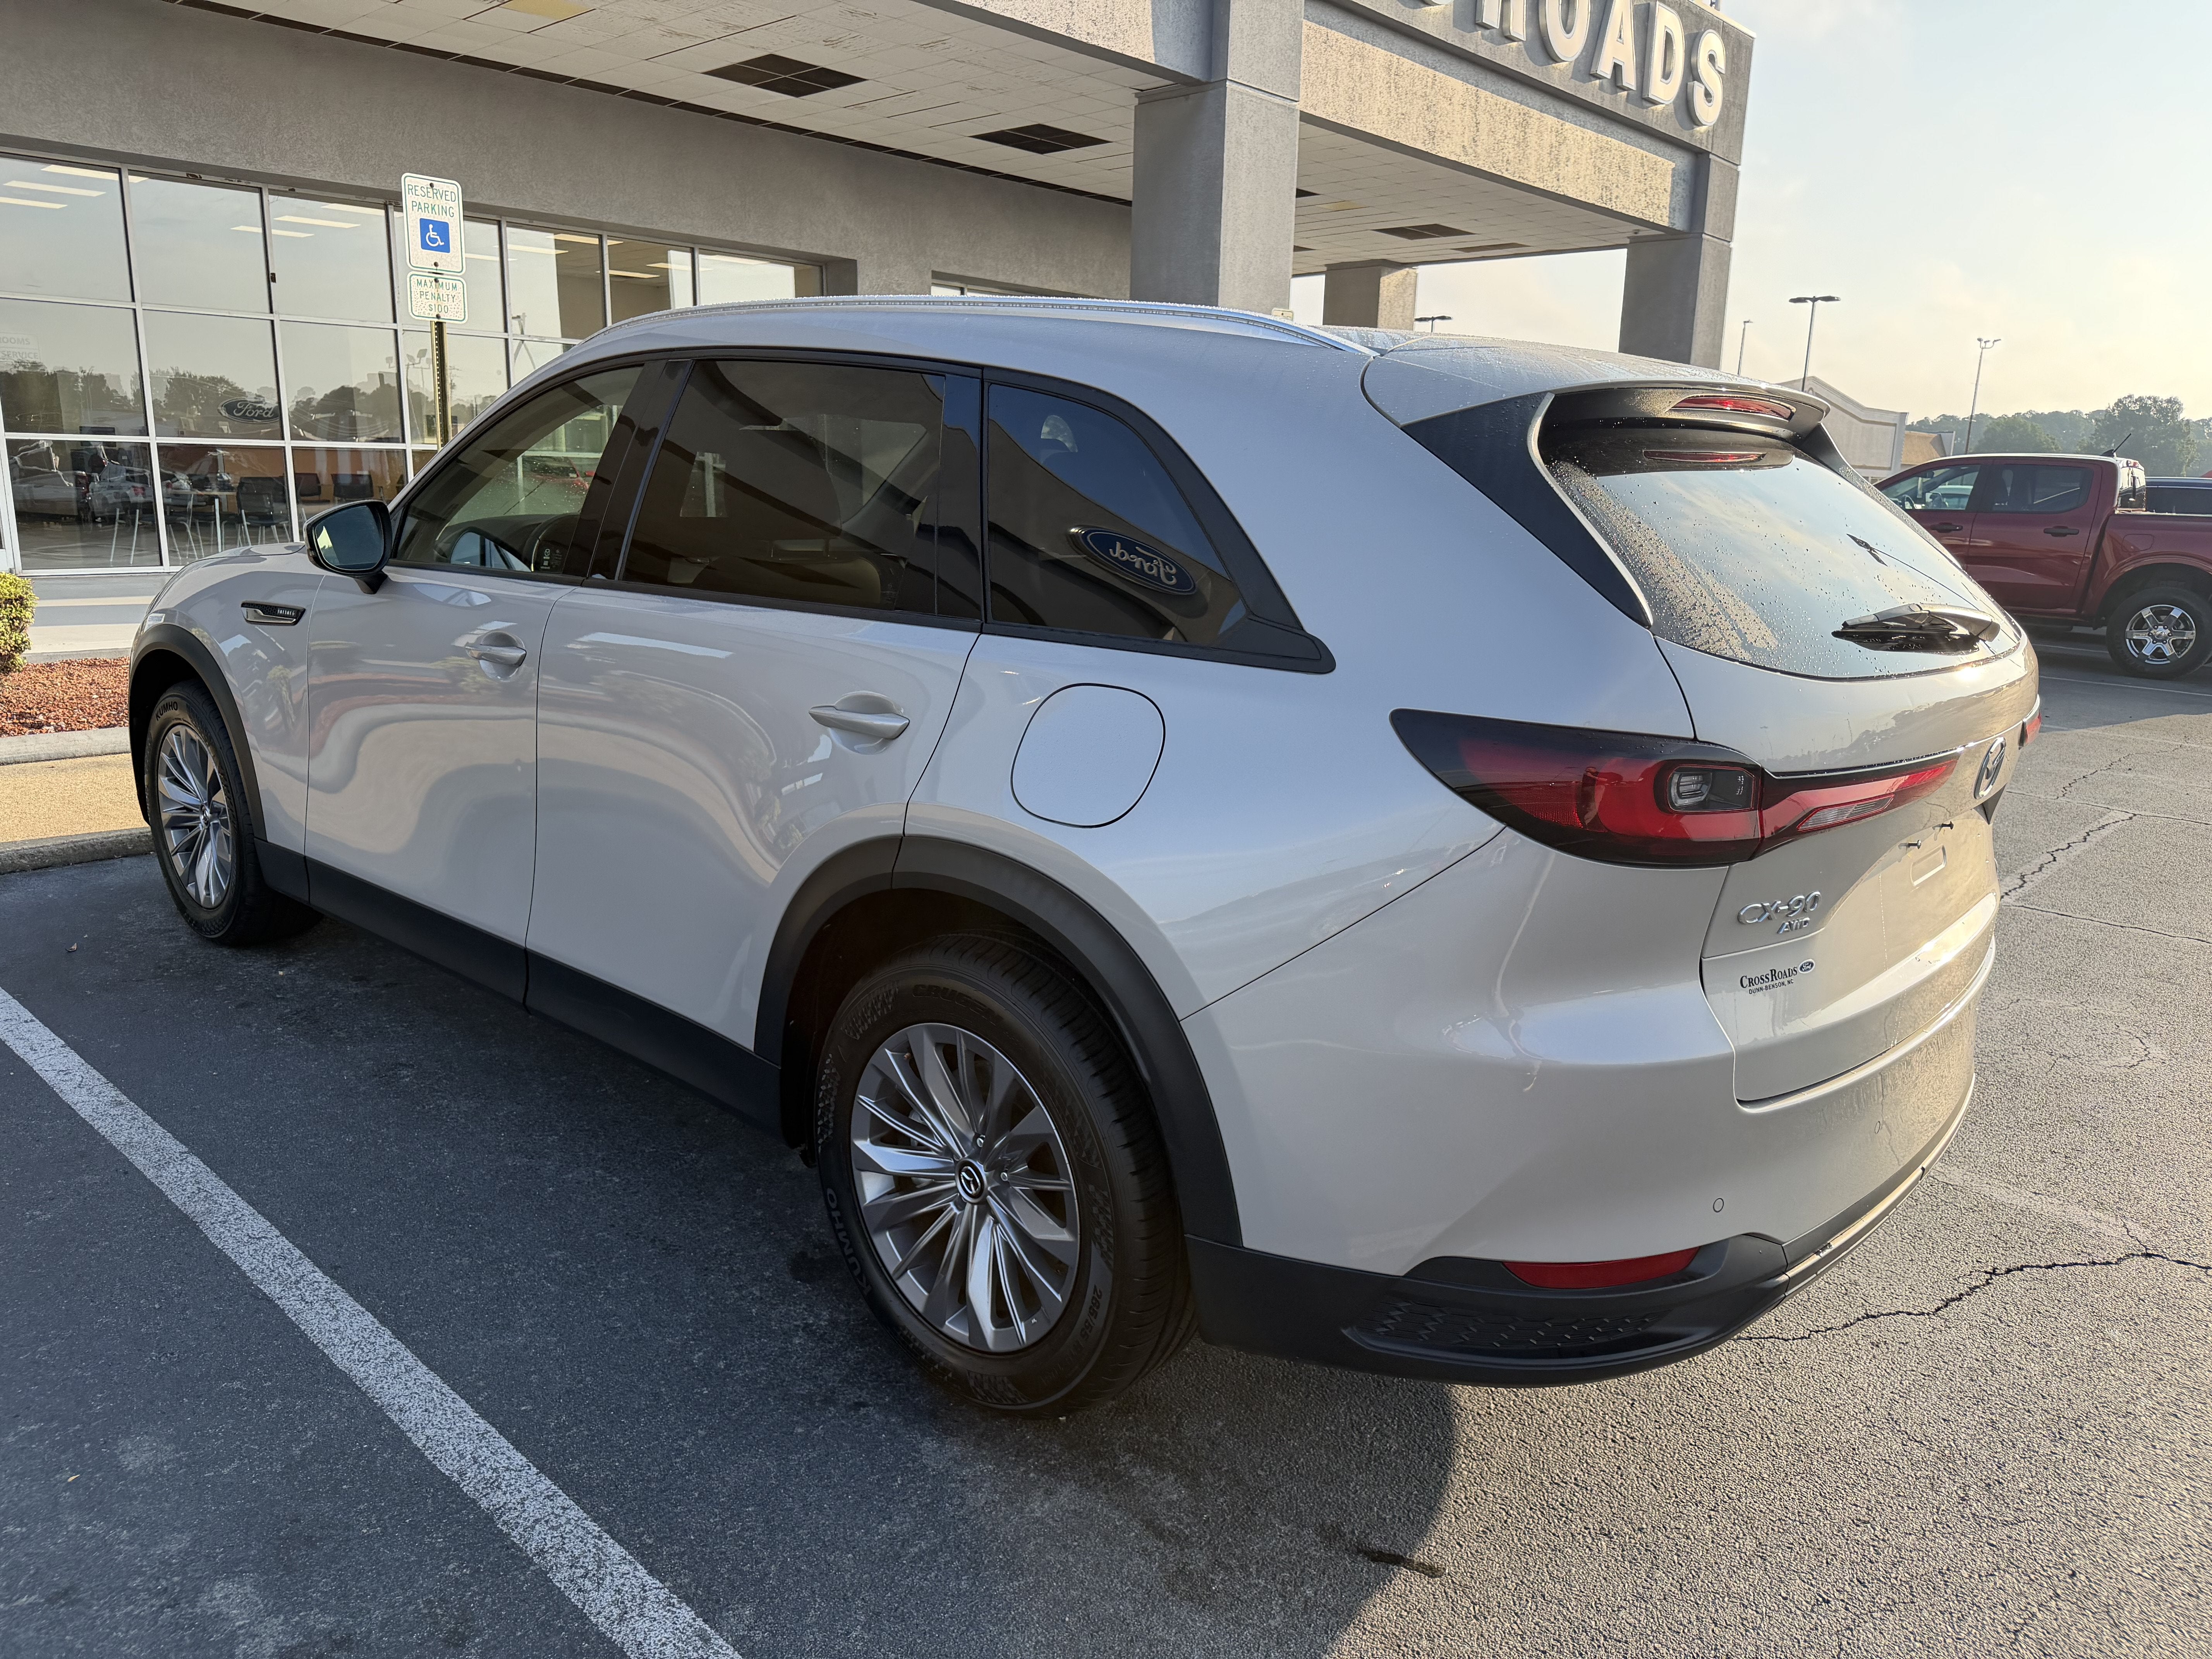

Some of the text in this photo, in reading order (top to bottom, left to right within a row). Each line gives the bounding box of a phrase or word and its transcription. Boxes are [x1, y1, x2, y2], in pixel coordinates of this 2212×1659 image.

[1431, 0, 1726, 126] OADS
[408, 184, 456, 202] RESERVED
[412, 201, 454, 218] PARKING
[417, 279, 457, 291] MAXIMUM
[419, 291, 455, 302] PENALTY
[233, 401, 275, 418] Ford
[156, 701, 178, 721] KUMHO
[1737, 891, 1821, 924] CX-90
[1777, 917, 1810, 934] AWD
[1749, 981, 1786, 994] DUNN-BENSON,
[827, 1187, 872, 1296] KUMHO
